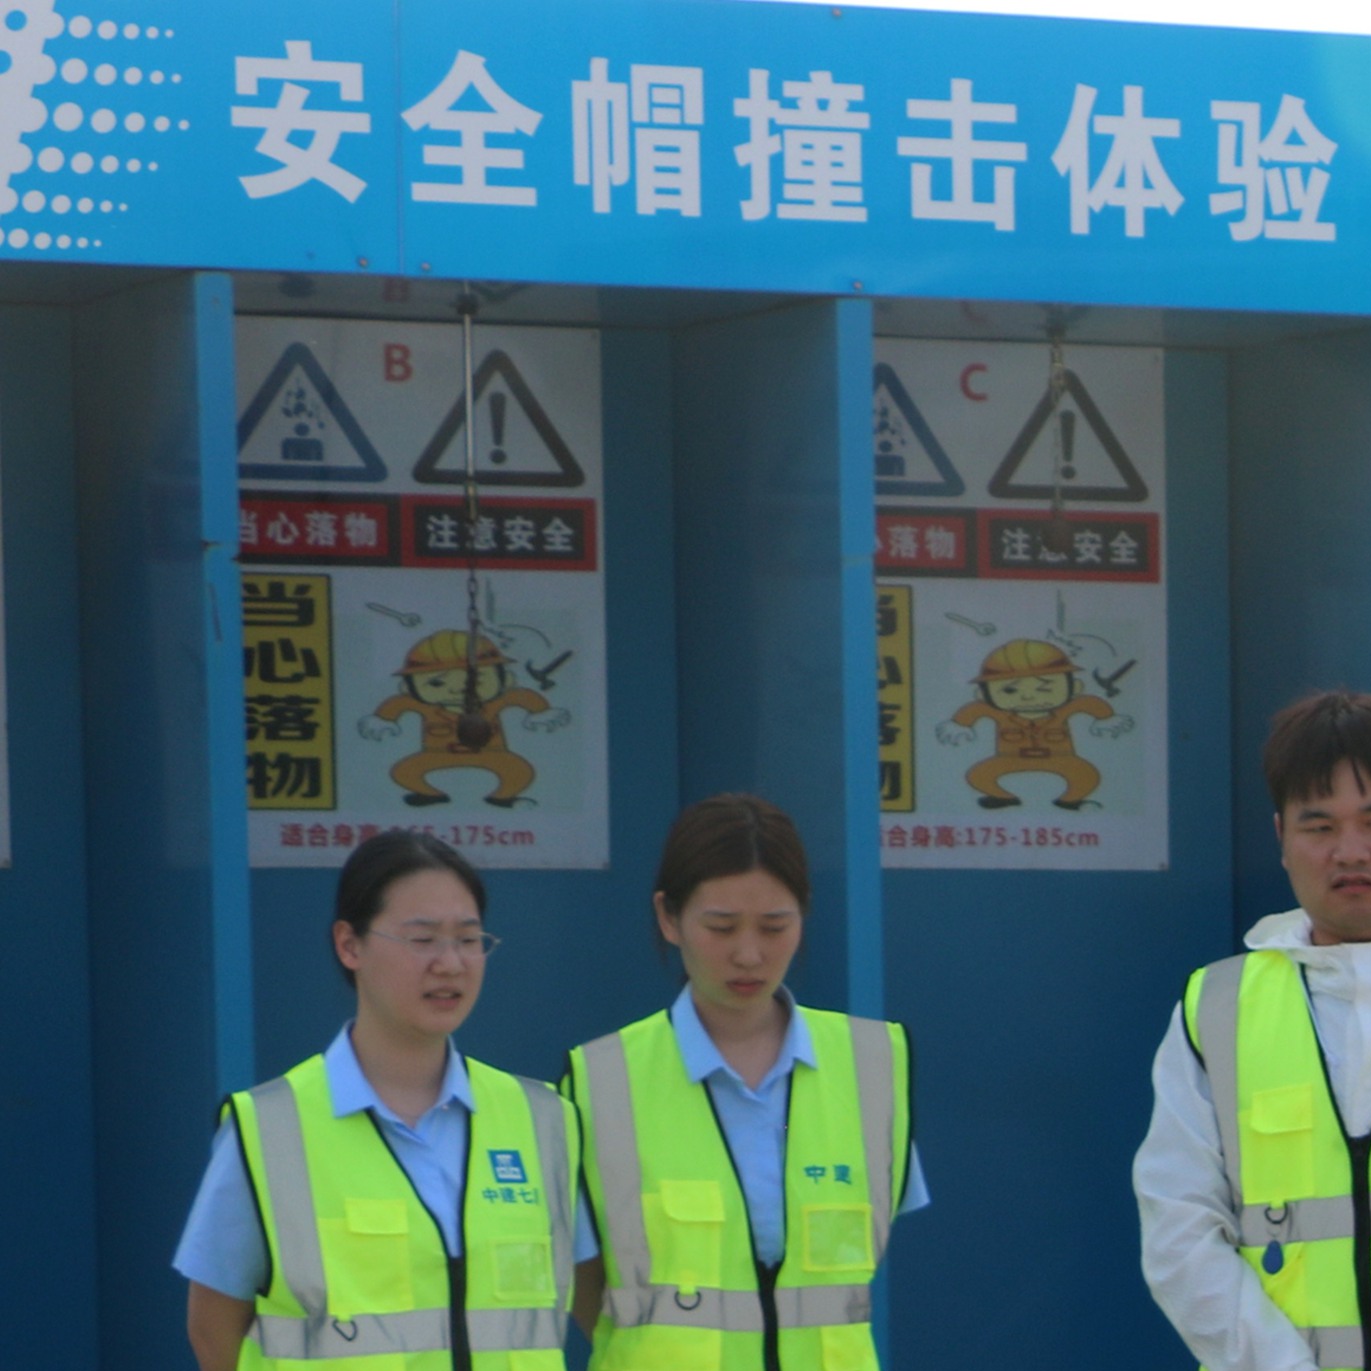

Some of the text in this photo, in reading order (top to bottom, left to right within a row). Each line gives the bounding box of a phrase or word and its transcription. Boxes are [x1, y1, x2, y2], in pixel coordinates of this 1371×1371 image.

[230, 40, 1339, 243] 安全帽撞击体验
[384, 342, 414, 382] B
[959, 362, 988, 402] C
[426, 513, 575, 552] 注意安全
[880, 824, 1099, 848] 合身高:175-185cm
